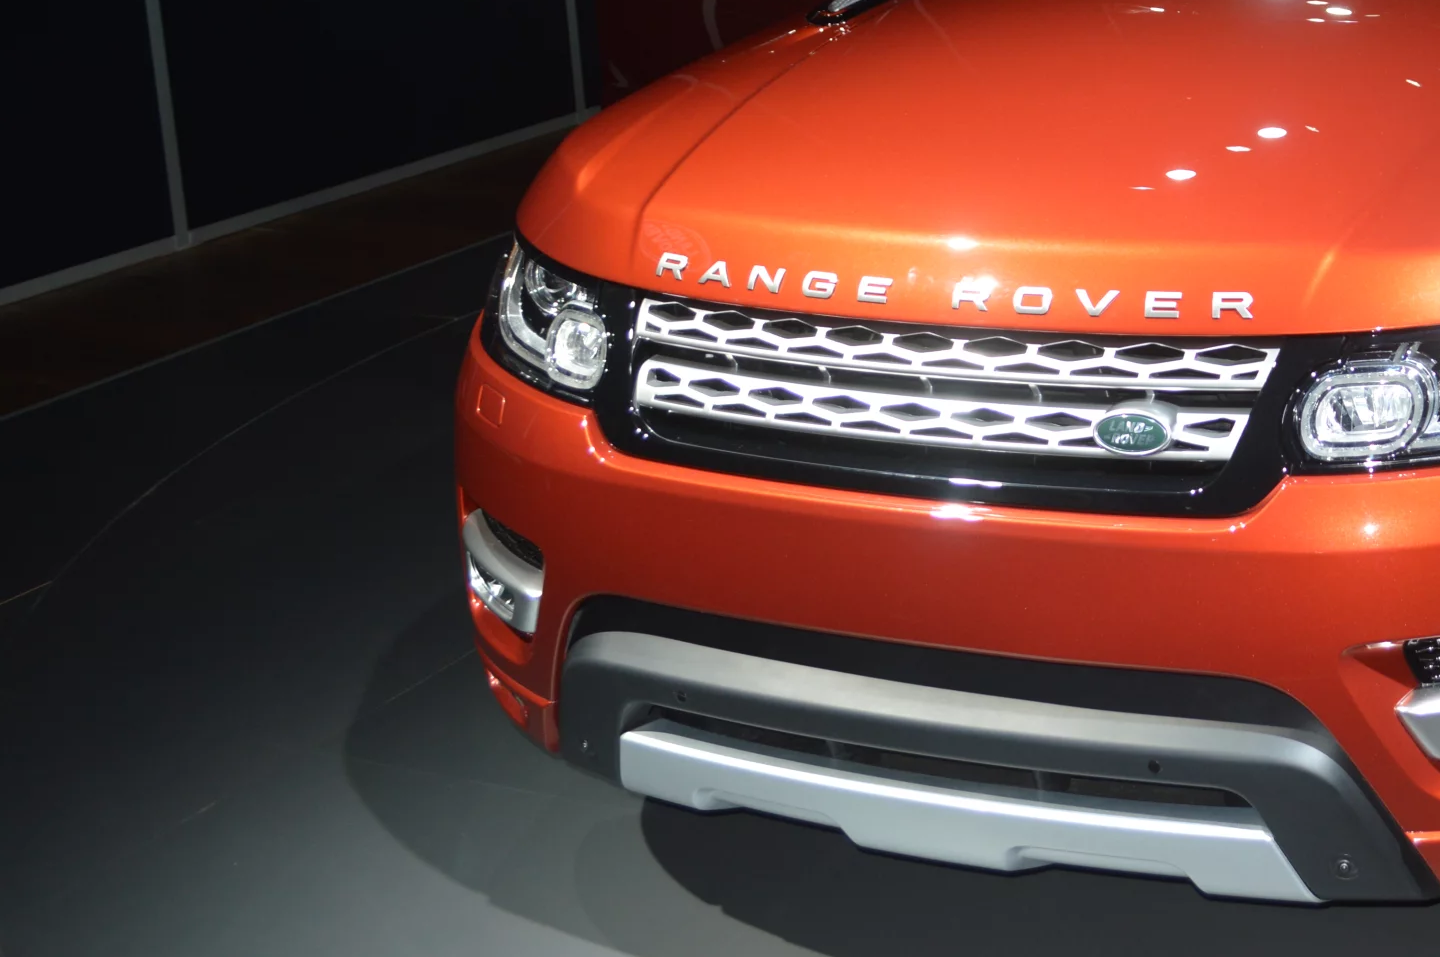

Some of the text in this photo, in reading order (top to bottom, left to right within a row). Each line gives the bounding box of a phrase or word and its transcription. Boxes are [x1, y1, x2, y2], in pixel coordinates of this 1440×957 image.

[656, 252, 1254, 319] RANGE ROVER
[1109, 420, 1146, 433] LAND
